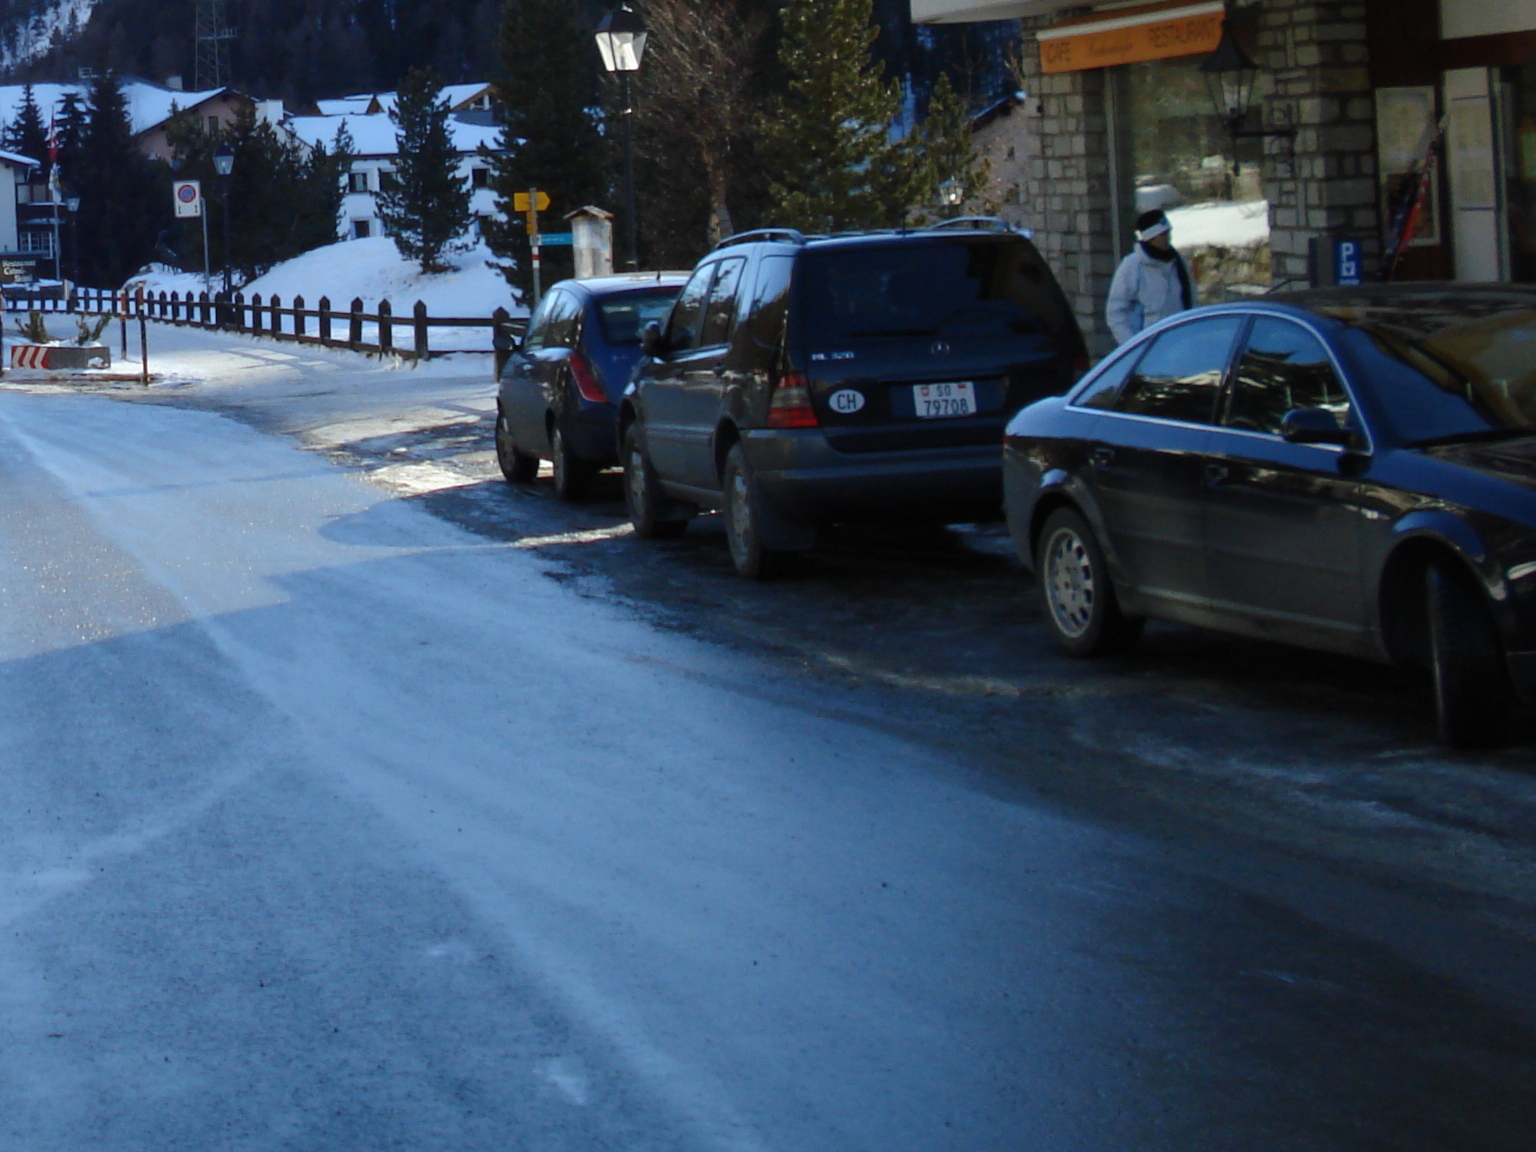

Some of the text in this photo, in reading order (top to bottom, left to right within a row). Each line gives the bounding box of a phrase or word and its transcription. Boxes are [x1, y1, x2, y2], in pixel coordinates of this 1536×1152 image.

[1342, 242, 1354, 261] P
[837, 394, 857, 410] CH
[924, 399, 969, 415] 79708
